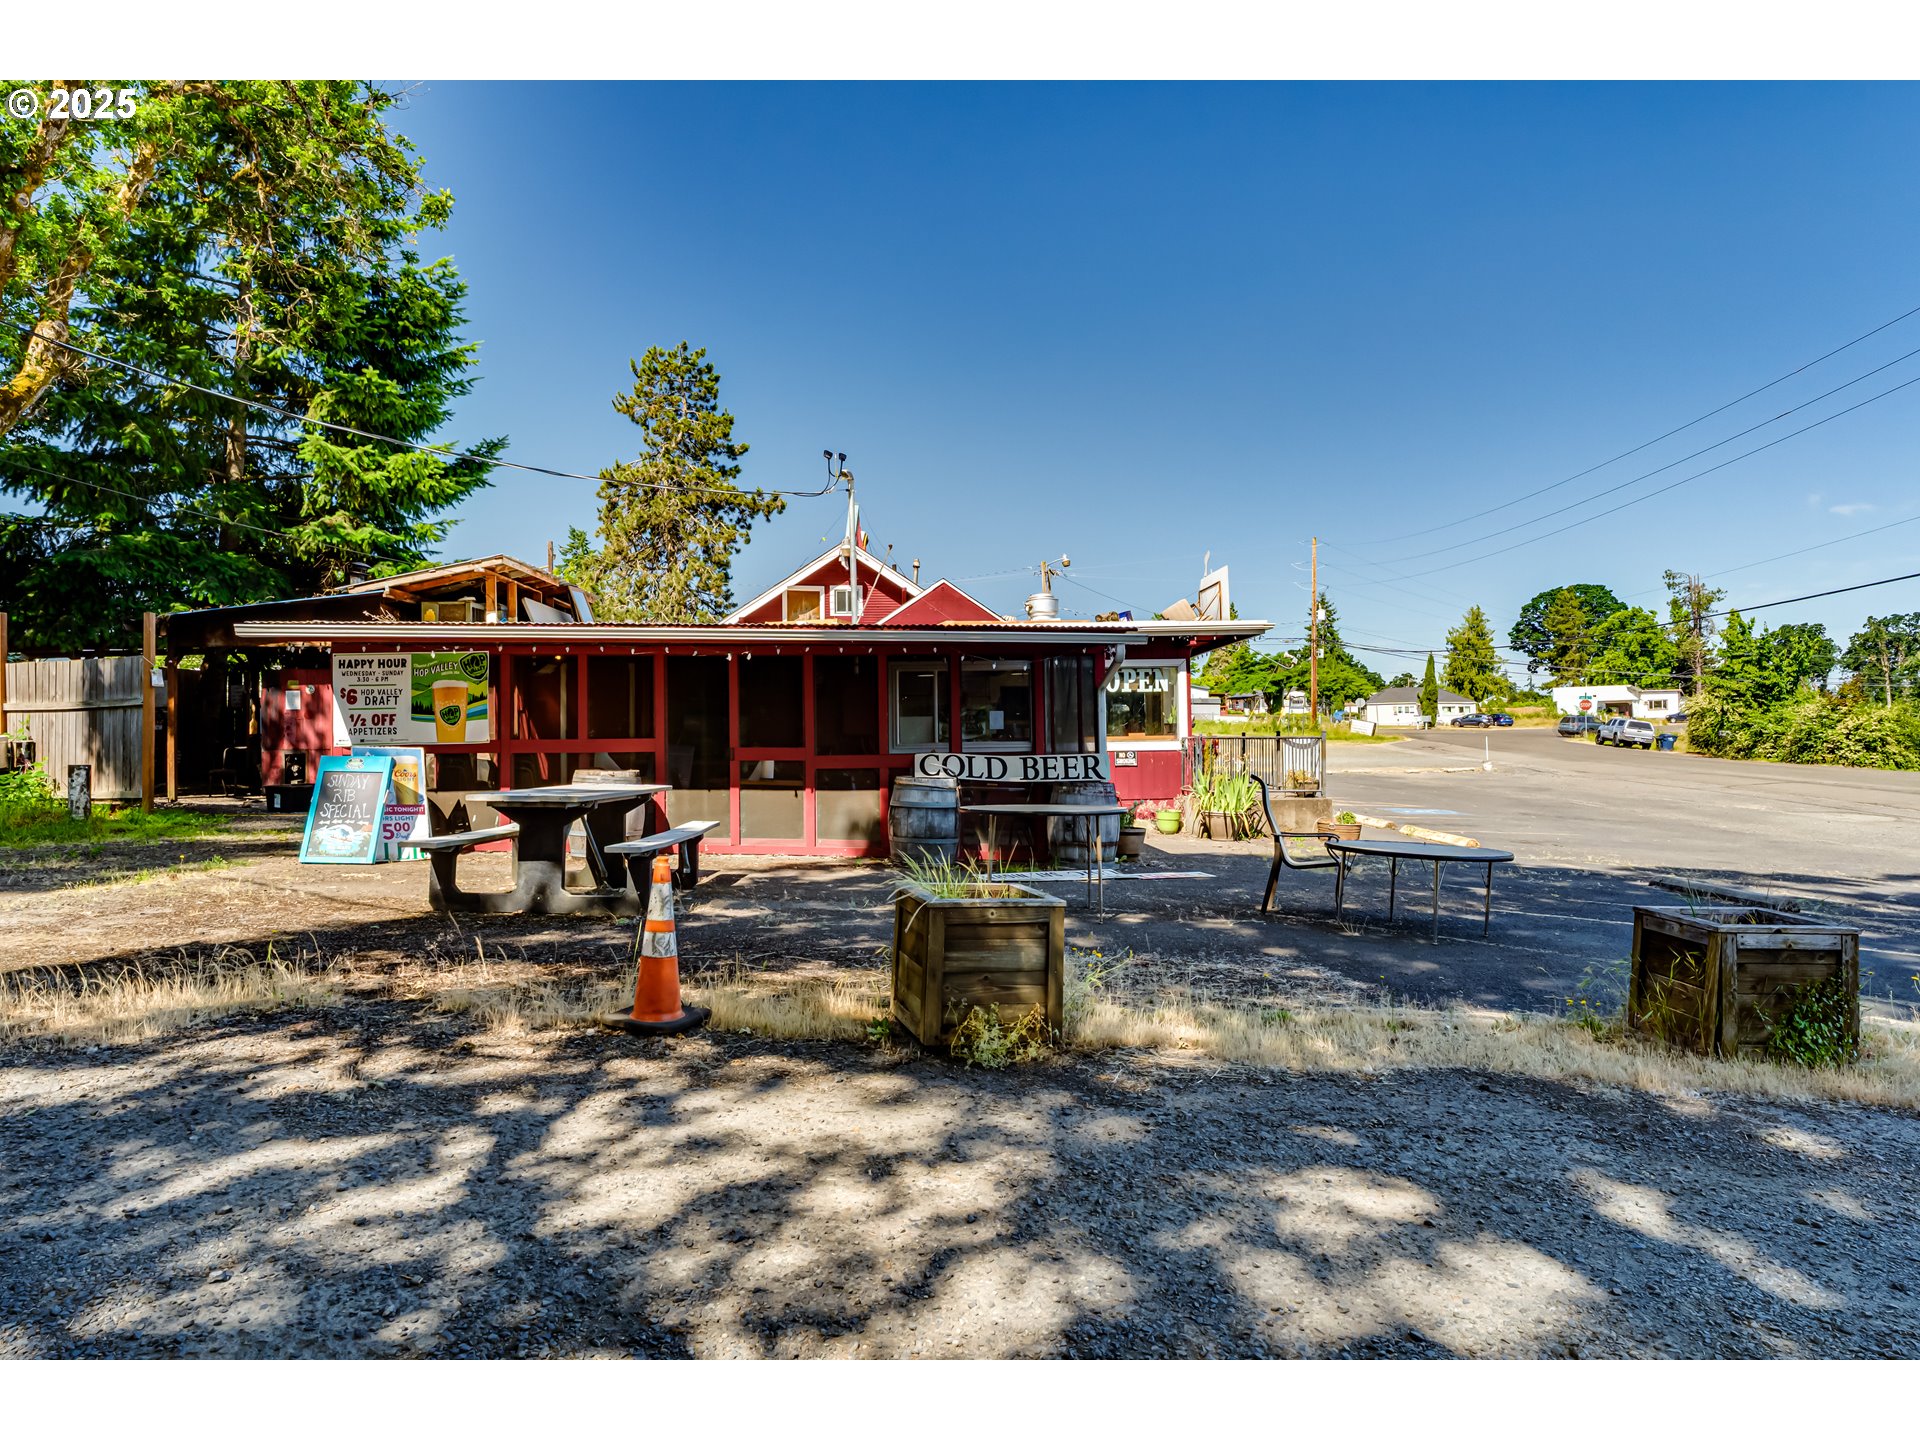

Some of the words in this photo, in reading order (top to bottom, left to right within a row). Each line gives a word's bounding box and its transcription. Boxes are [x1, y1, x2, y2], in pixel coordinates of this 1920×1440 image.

[338, 659, 374, 669] HAPPY
[377, 658, 407, 669] HOUR
[413, 668, 429, 677] HOP
[430, 662, 459, 674] VALLEY
[340, 687, 358, 705] $6
[377, 688, 403, 696] VALLEY
[364, 695, 400, 706] DRAFT
[371, 713, 397, 727] OFF
[348, 727, 398, 736] APPETIZERS
[394, 769, 417, 778] Coors
[919, 754, 1008, 780] COLD
[1019, 755, 1107, 781] BEER
[327, 774, 370, 790] SUNDAY
[332, 788, 356, 803] RIB
[320, 802, 371, 819] SPECIAL
